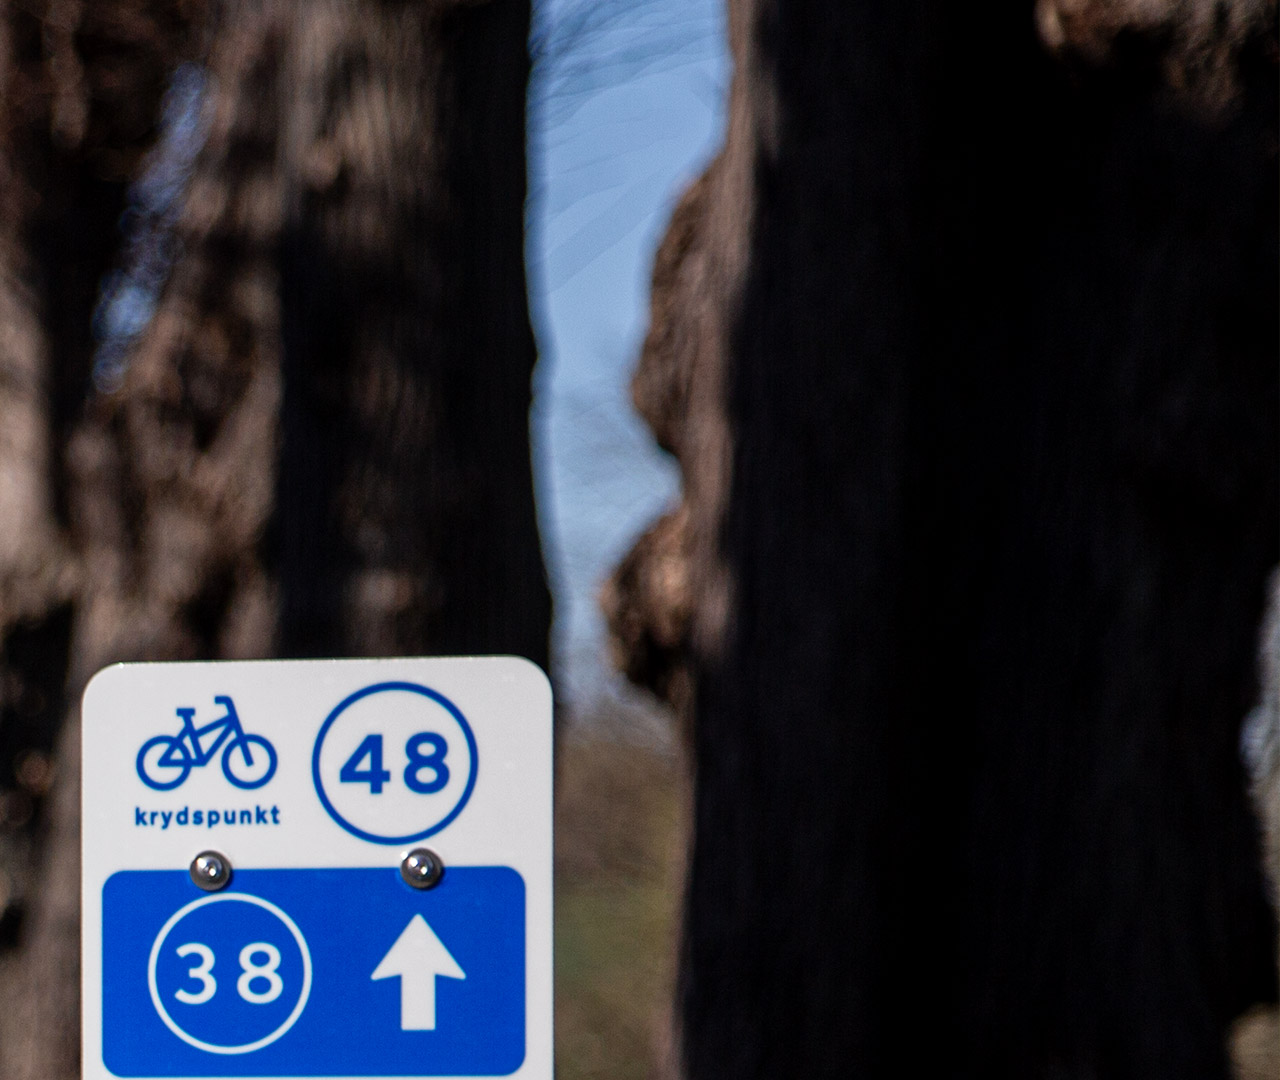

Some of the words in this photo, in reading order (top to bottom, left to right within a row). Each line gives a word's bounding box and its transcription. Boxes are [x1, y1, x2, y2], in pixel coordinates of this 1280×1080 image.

[339, 731, 450, 795] 48
[134, 805, 281, 830] krydspunkt
[175, 942, 283, 1005] 38
